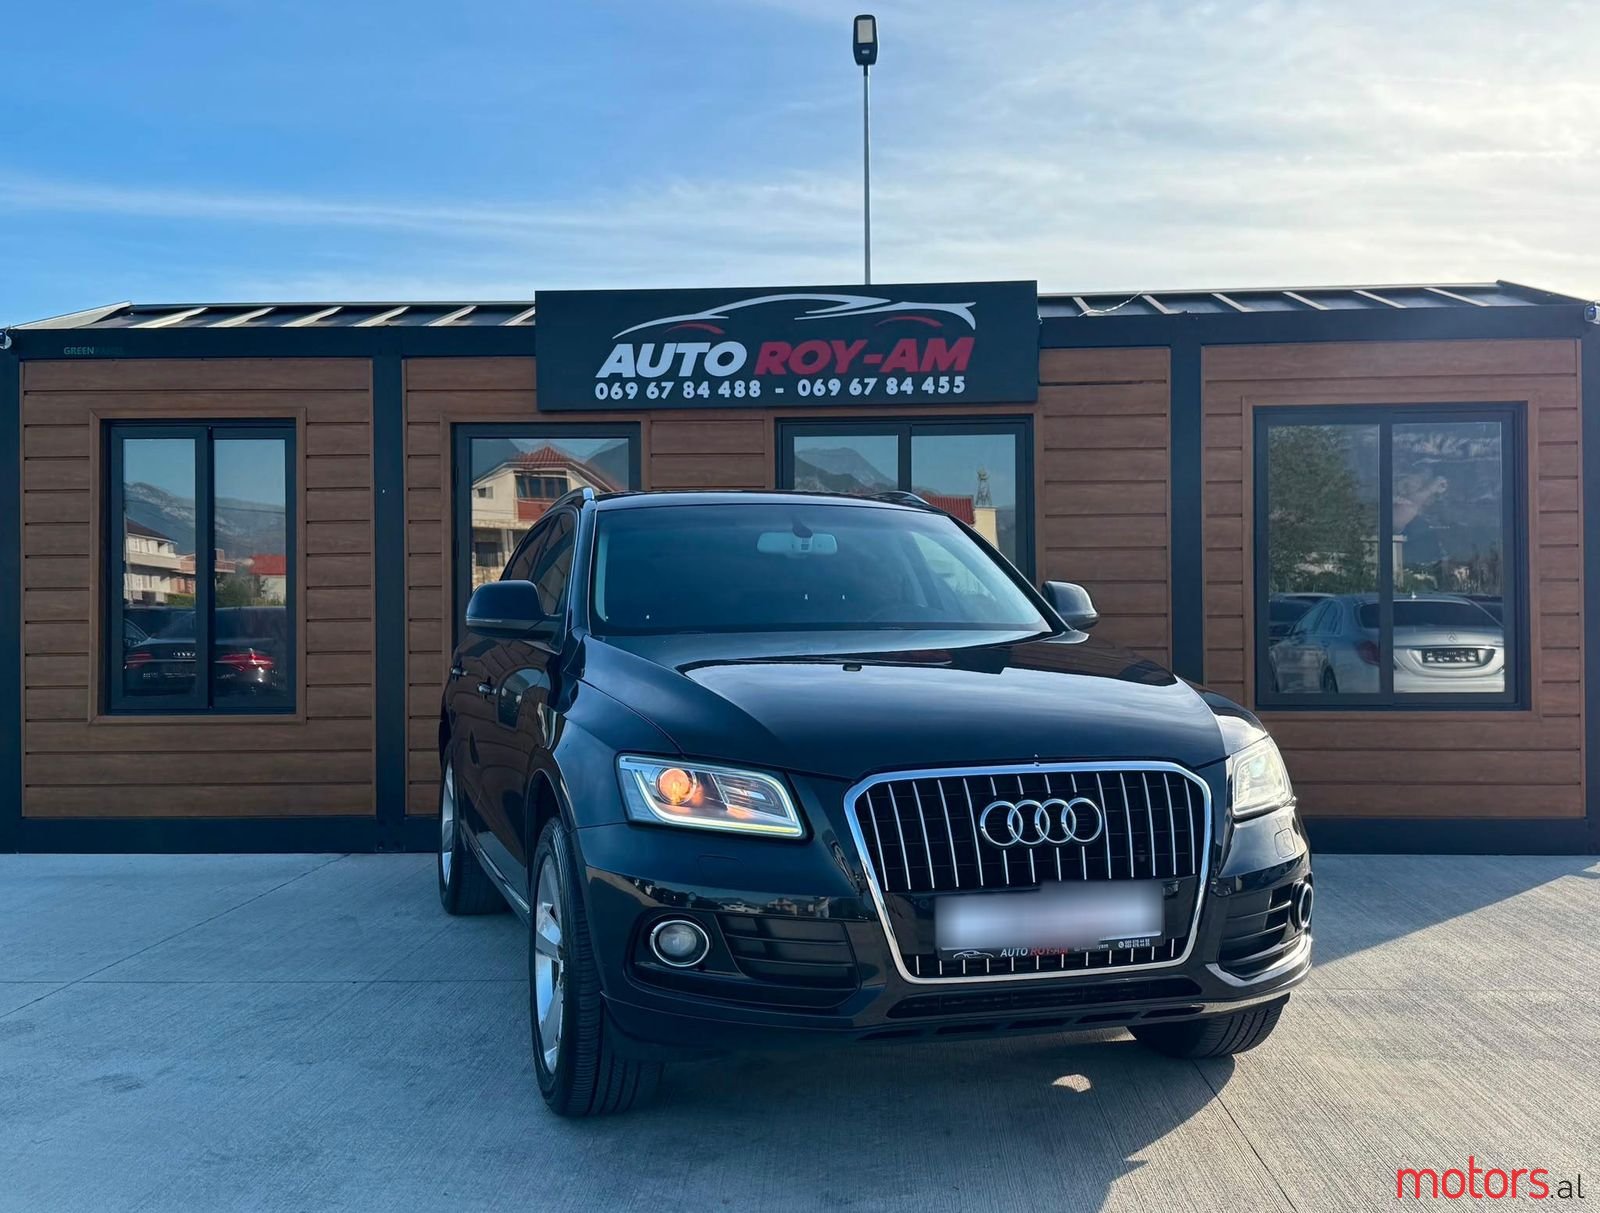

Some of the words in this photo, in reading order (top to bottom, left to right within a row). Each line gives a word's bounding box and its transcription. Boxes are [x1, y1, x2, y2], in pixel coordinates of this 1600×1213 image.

[63, 346, 95, 355] GREEN
[595, 341, 747, 378] AUTO
[754, 337, 975, 375] ROY-AM
[595, 382, 638, 400] 069
[646, 381, 675, 399] 67
[682, 380, 710, 399] 84
[718, 379, 761, 398] 488
[797, 378, 841, 397] 069
[849, 377, 878, 396] 67
[886, 377, 914, 395] 84
[921, 376, 965, 394] 455
[1000, 947, 1028, 957] AUTO
